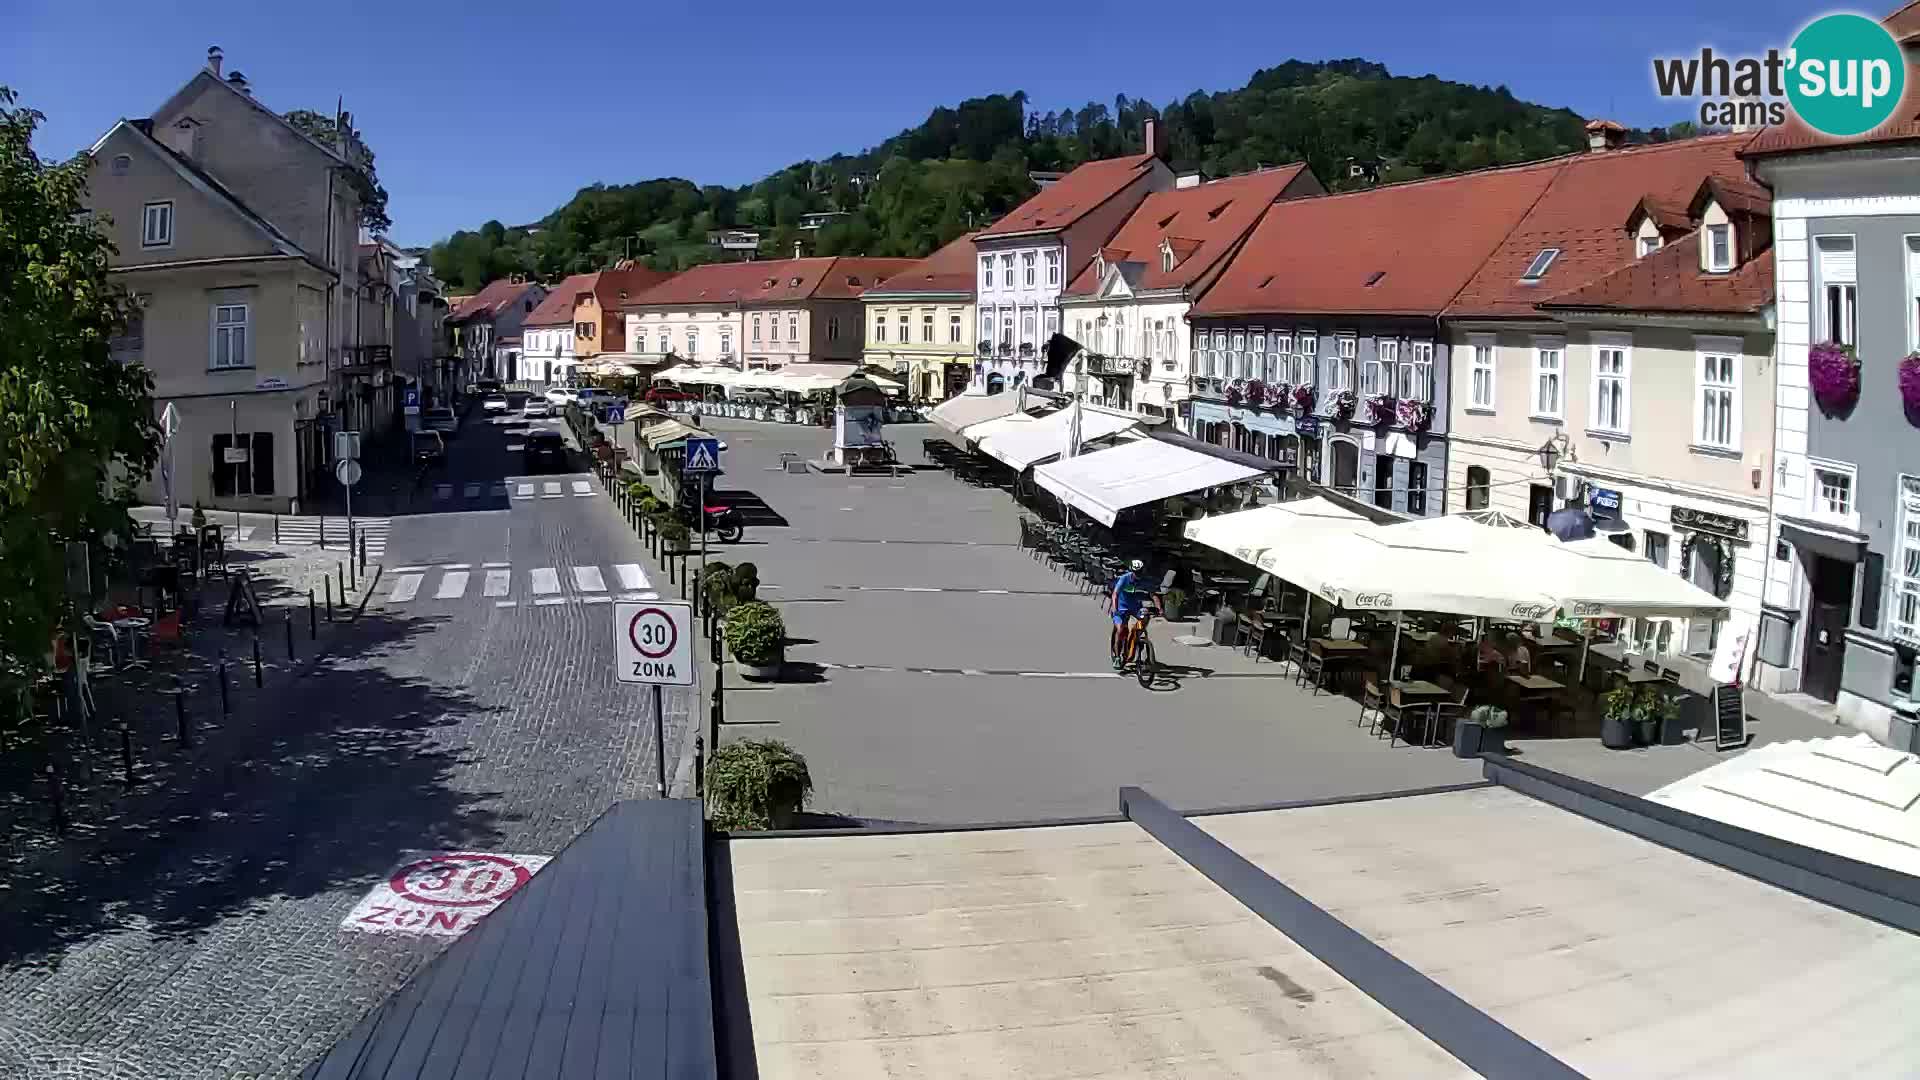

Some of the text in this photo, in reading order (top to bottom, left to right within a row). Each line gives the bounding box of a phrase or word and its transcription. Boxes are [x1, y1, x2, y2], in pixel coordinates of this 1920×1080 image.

[407, 392, 416, 405] P
[642, 624, 666, 645] 30
[632, 661, 677, 679] ZONA
[418, 866, 504, 894] 30
[358, 906, 480, 930] ZON
